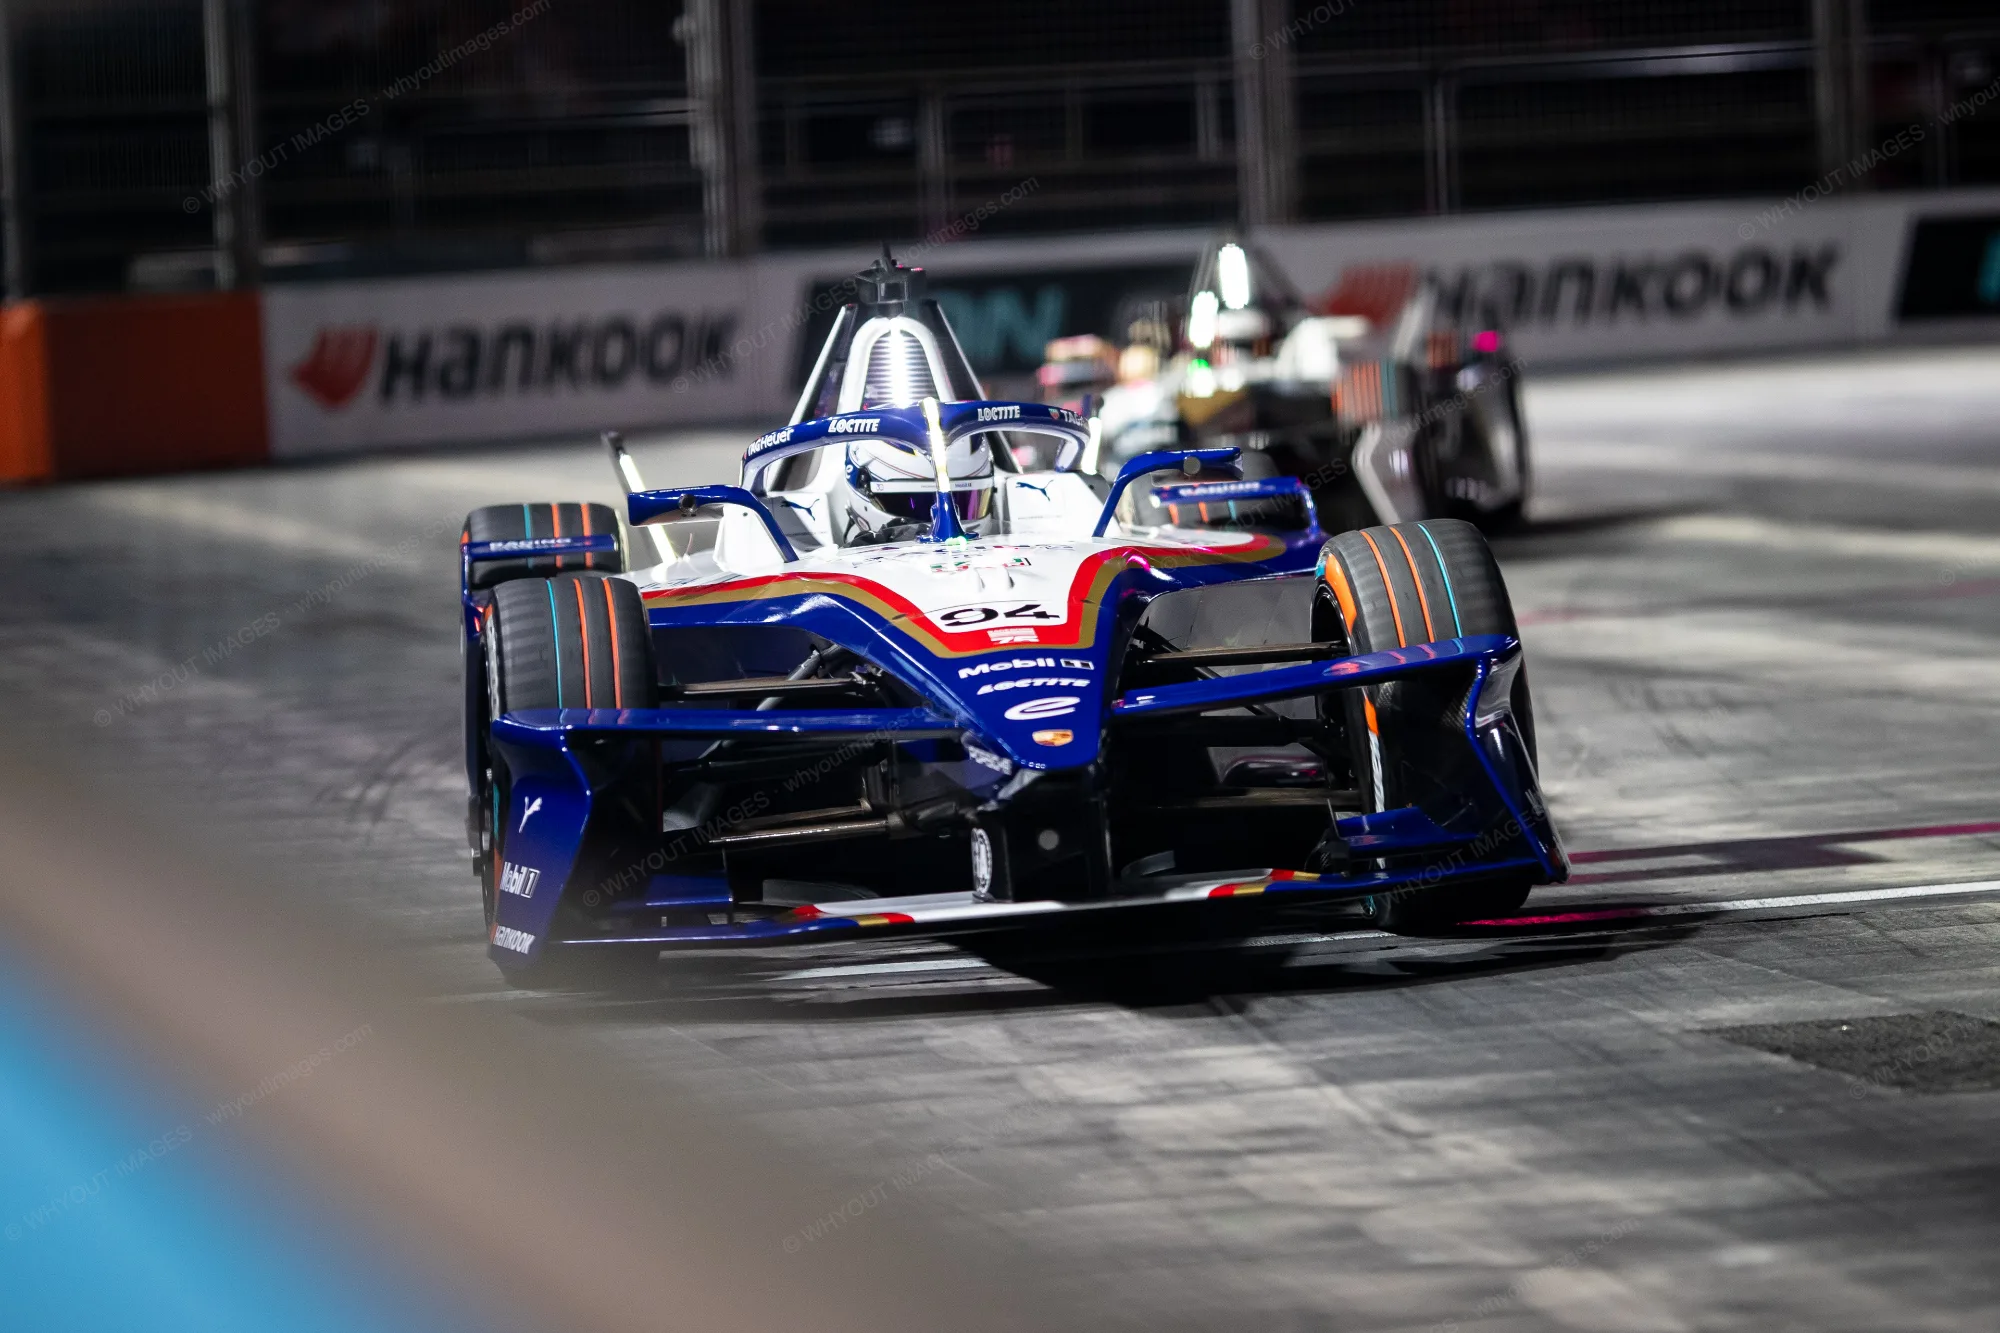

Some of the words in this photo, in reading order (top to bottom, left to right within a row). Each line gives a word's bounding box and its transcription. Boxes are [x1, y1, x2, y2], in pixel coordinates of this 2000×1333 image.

[978, 405, 1020, 421] LOCTITE
[828, 418, 880, 432] LOCTITE
[940, 604, 1060, 626] 94
[958, 658, 1055, 679] Mobil
[977, 677, 1091, 695] LOCTITE
[500, 861, 528, 895] Mobil
